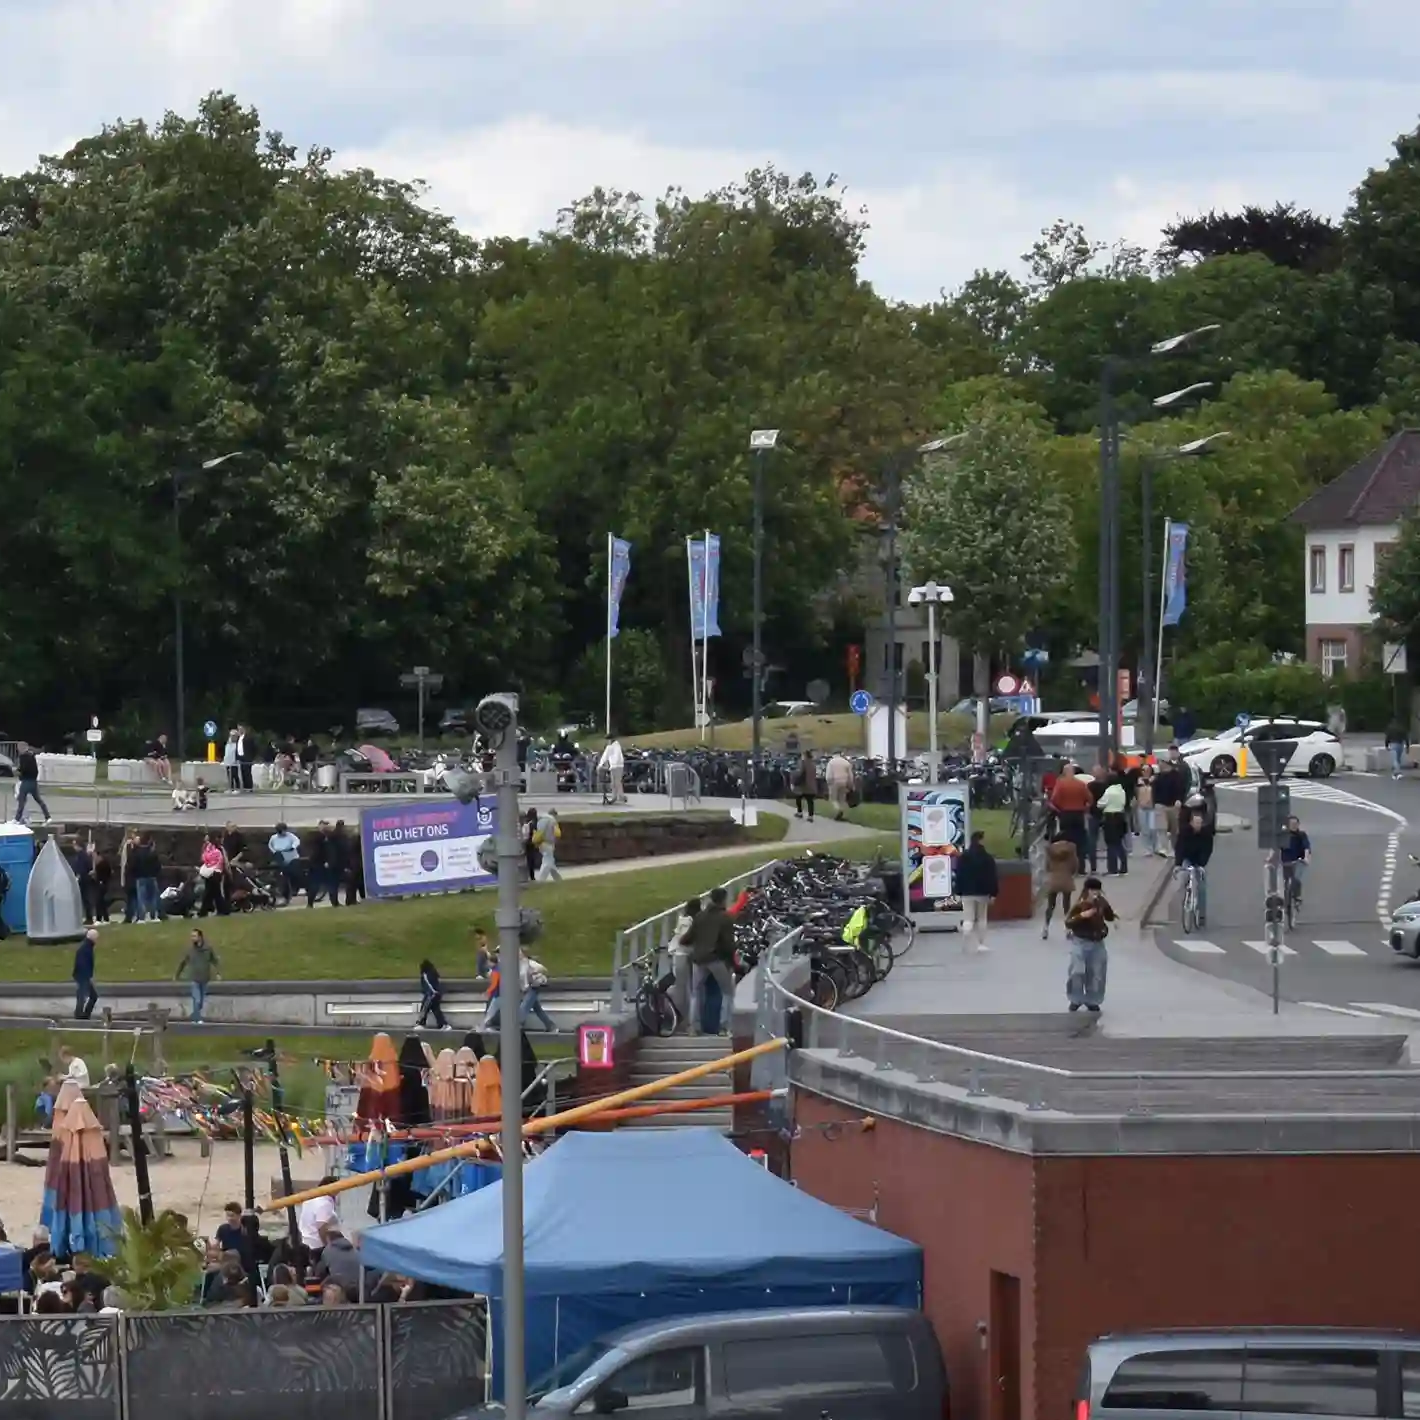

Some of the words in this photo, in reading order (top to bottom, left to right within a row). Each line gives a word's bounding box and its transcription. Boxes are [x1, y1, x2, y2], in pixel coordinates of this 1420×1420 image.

[373, 828, 402, 842] MELD
[404, 826, 425, 839] HET
[426, 823, 449, 837] ONS
